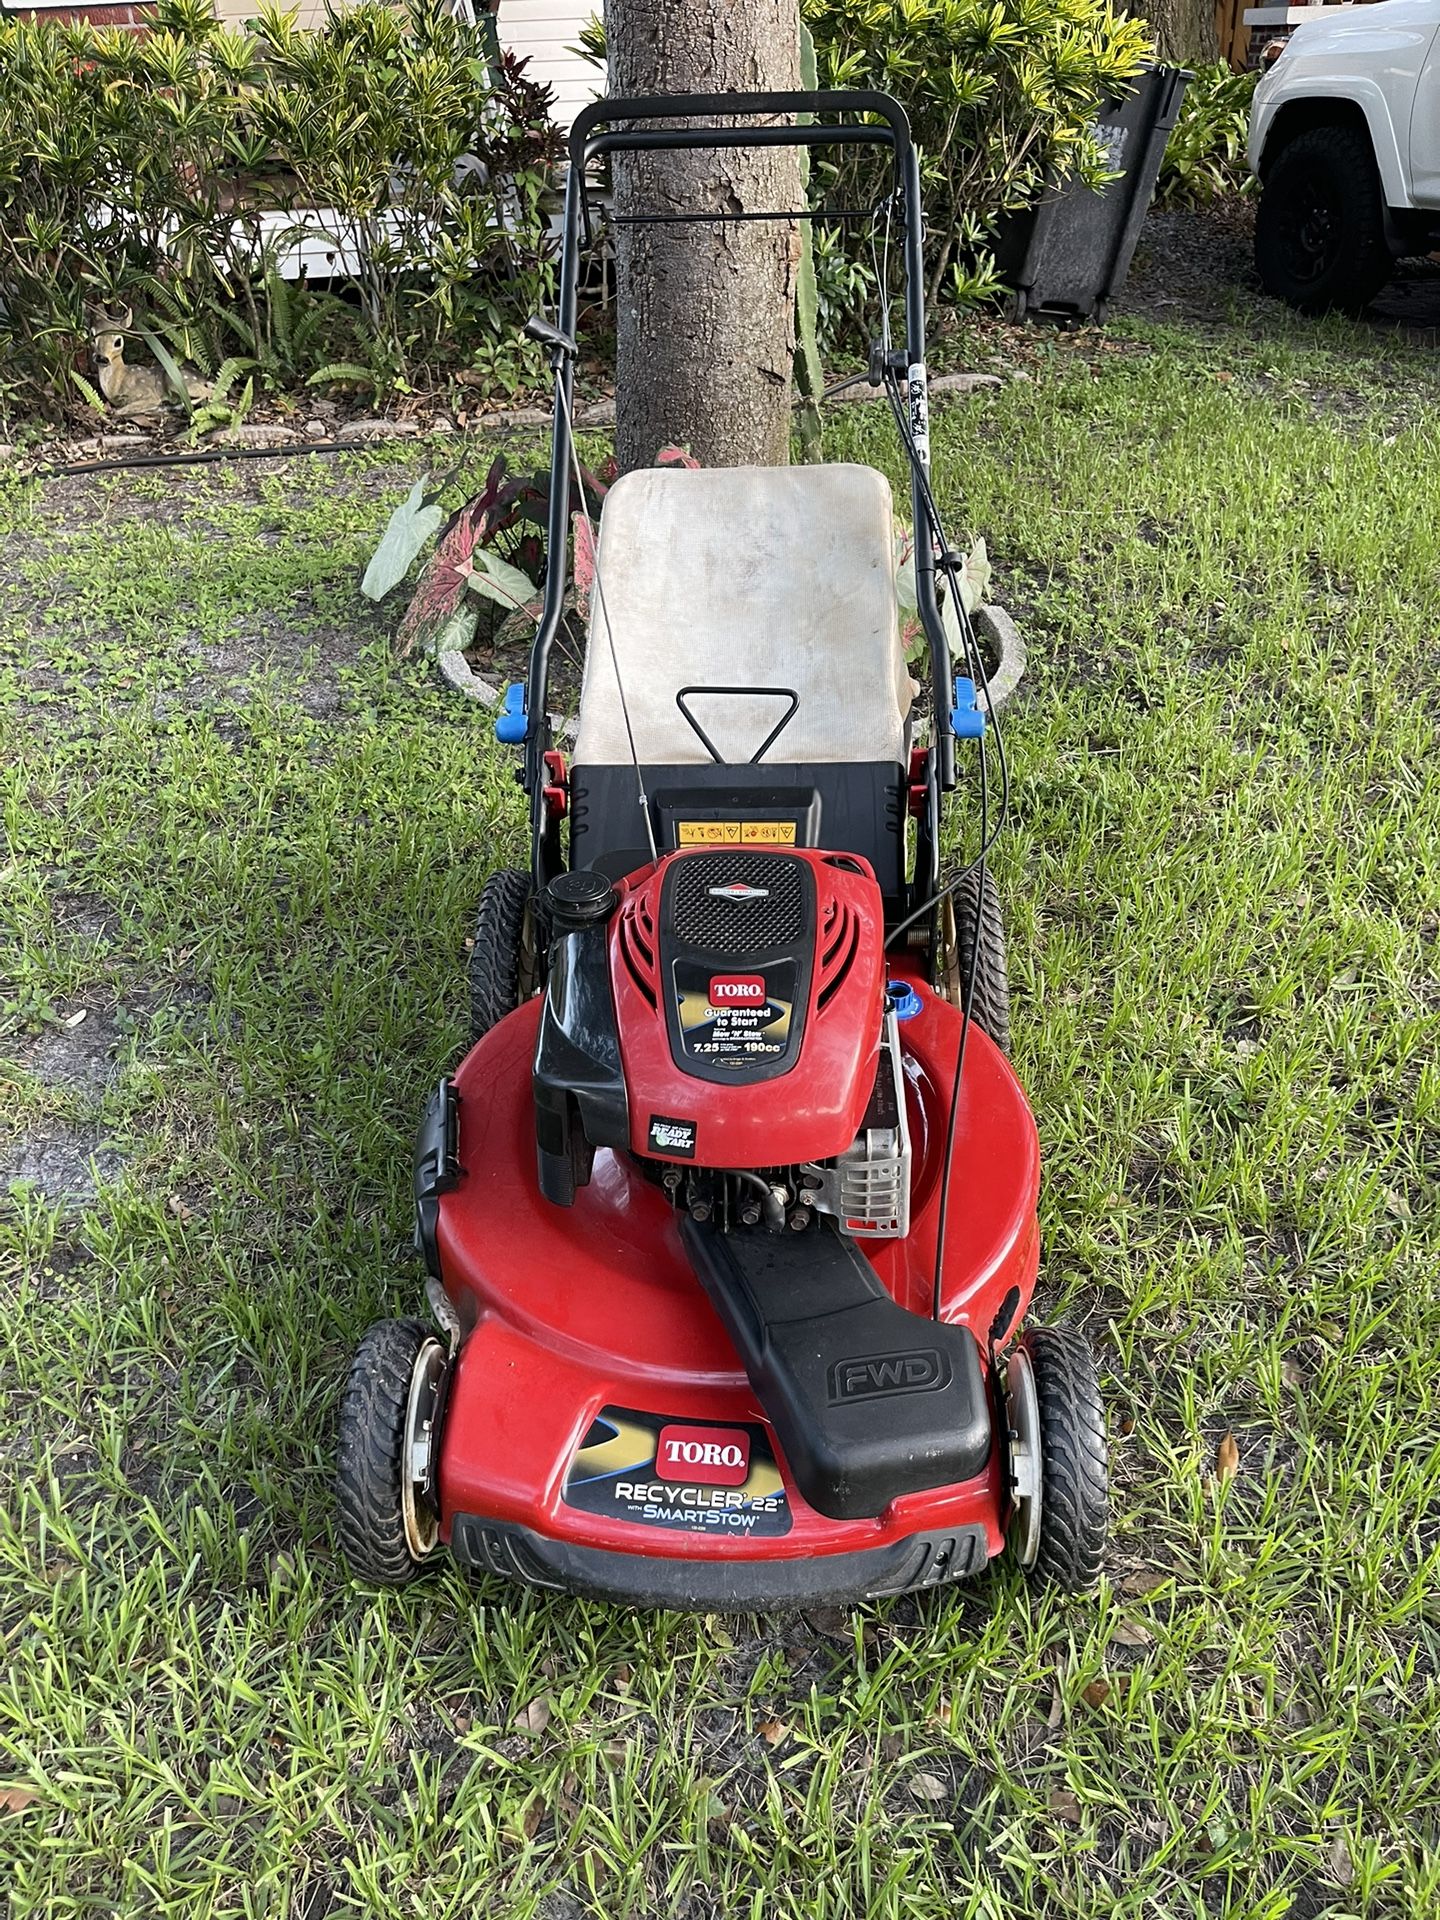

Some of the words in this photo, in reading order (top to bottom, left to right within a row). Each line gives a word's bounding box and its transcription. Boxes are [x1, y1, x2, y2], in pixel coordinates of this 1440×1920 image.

[714, 984, 761, 997] TORO
[704, 1007, 771, 1017] Guaranteed
[716, 1018, 728, 1027] to
[730, 1017, 758, 1027] Start
[693, 1043, 719, 1053] 7.25
[744, 1042, 781, 1053] 190cc
[845, 1358, 933, 1392] FWD
[614, 1481, 745, 1510] RECYCLER
[752, 1496, 784, 1513] 22"
